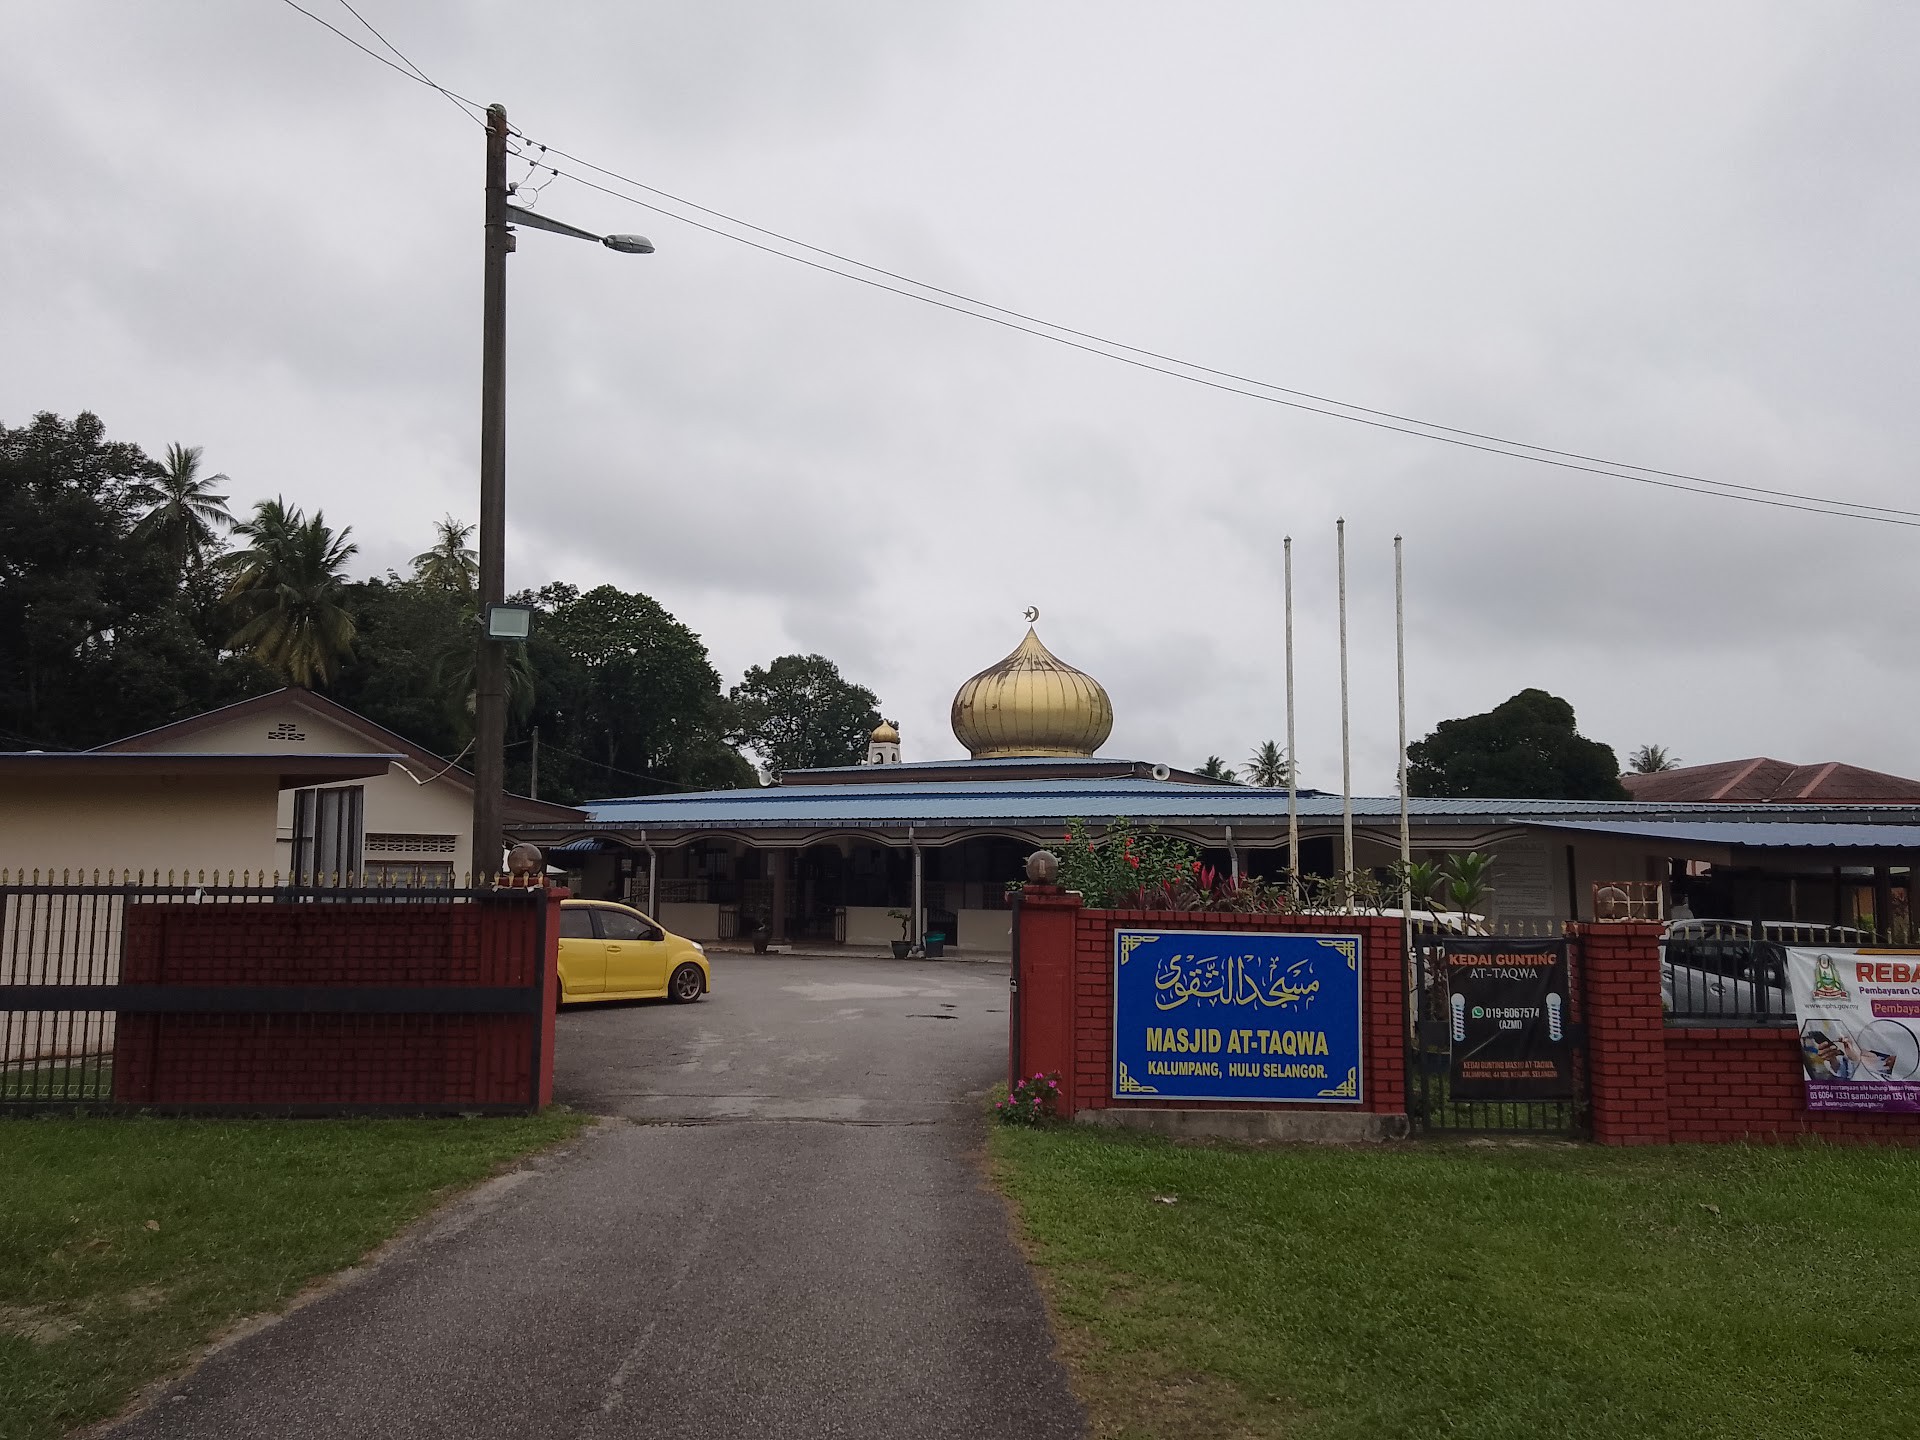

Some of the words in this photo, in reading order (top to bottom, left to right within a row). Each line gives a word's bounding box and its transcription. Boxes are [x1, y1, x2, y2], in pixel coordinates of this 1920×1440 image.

[1449, 954, 1492, 966] KEDAI
[1495, 954, 1557, 966] GUNTING
[1470, 968, 1538, 981] AT-TAQWA
[1859, 986, 1910, 996] Pembayaran
[1486, 1007, 1540, 1018] 019-6067574
[1499, 1020, 1523, 1030] (AZMI)
[1146, 1027, 1222, 1054] MASJID
[1227, 1029, 1329, 1056] AT-TAQWA
[1147, 1060, 1223, 1079] KALUMPANG,
[1229, 1062, 1260, 1078] HULU
[1263, 1063, 1329, 1079] SELANGOR.
[1850, 1092, 1892, 1101] sambungan
